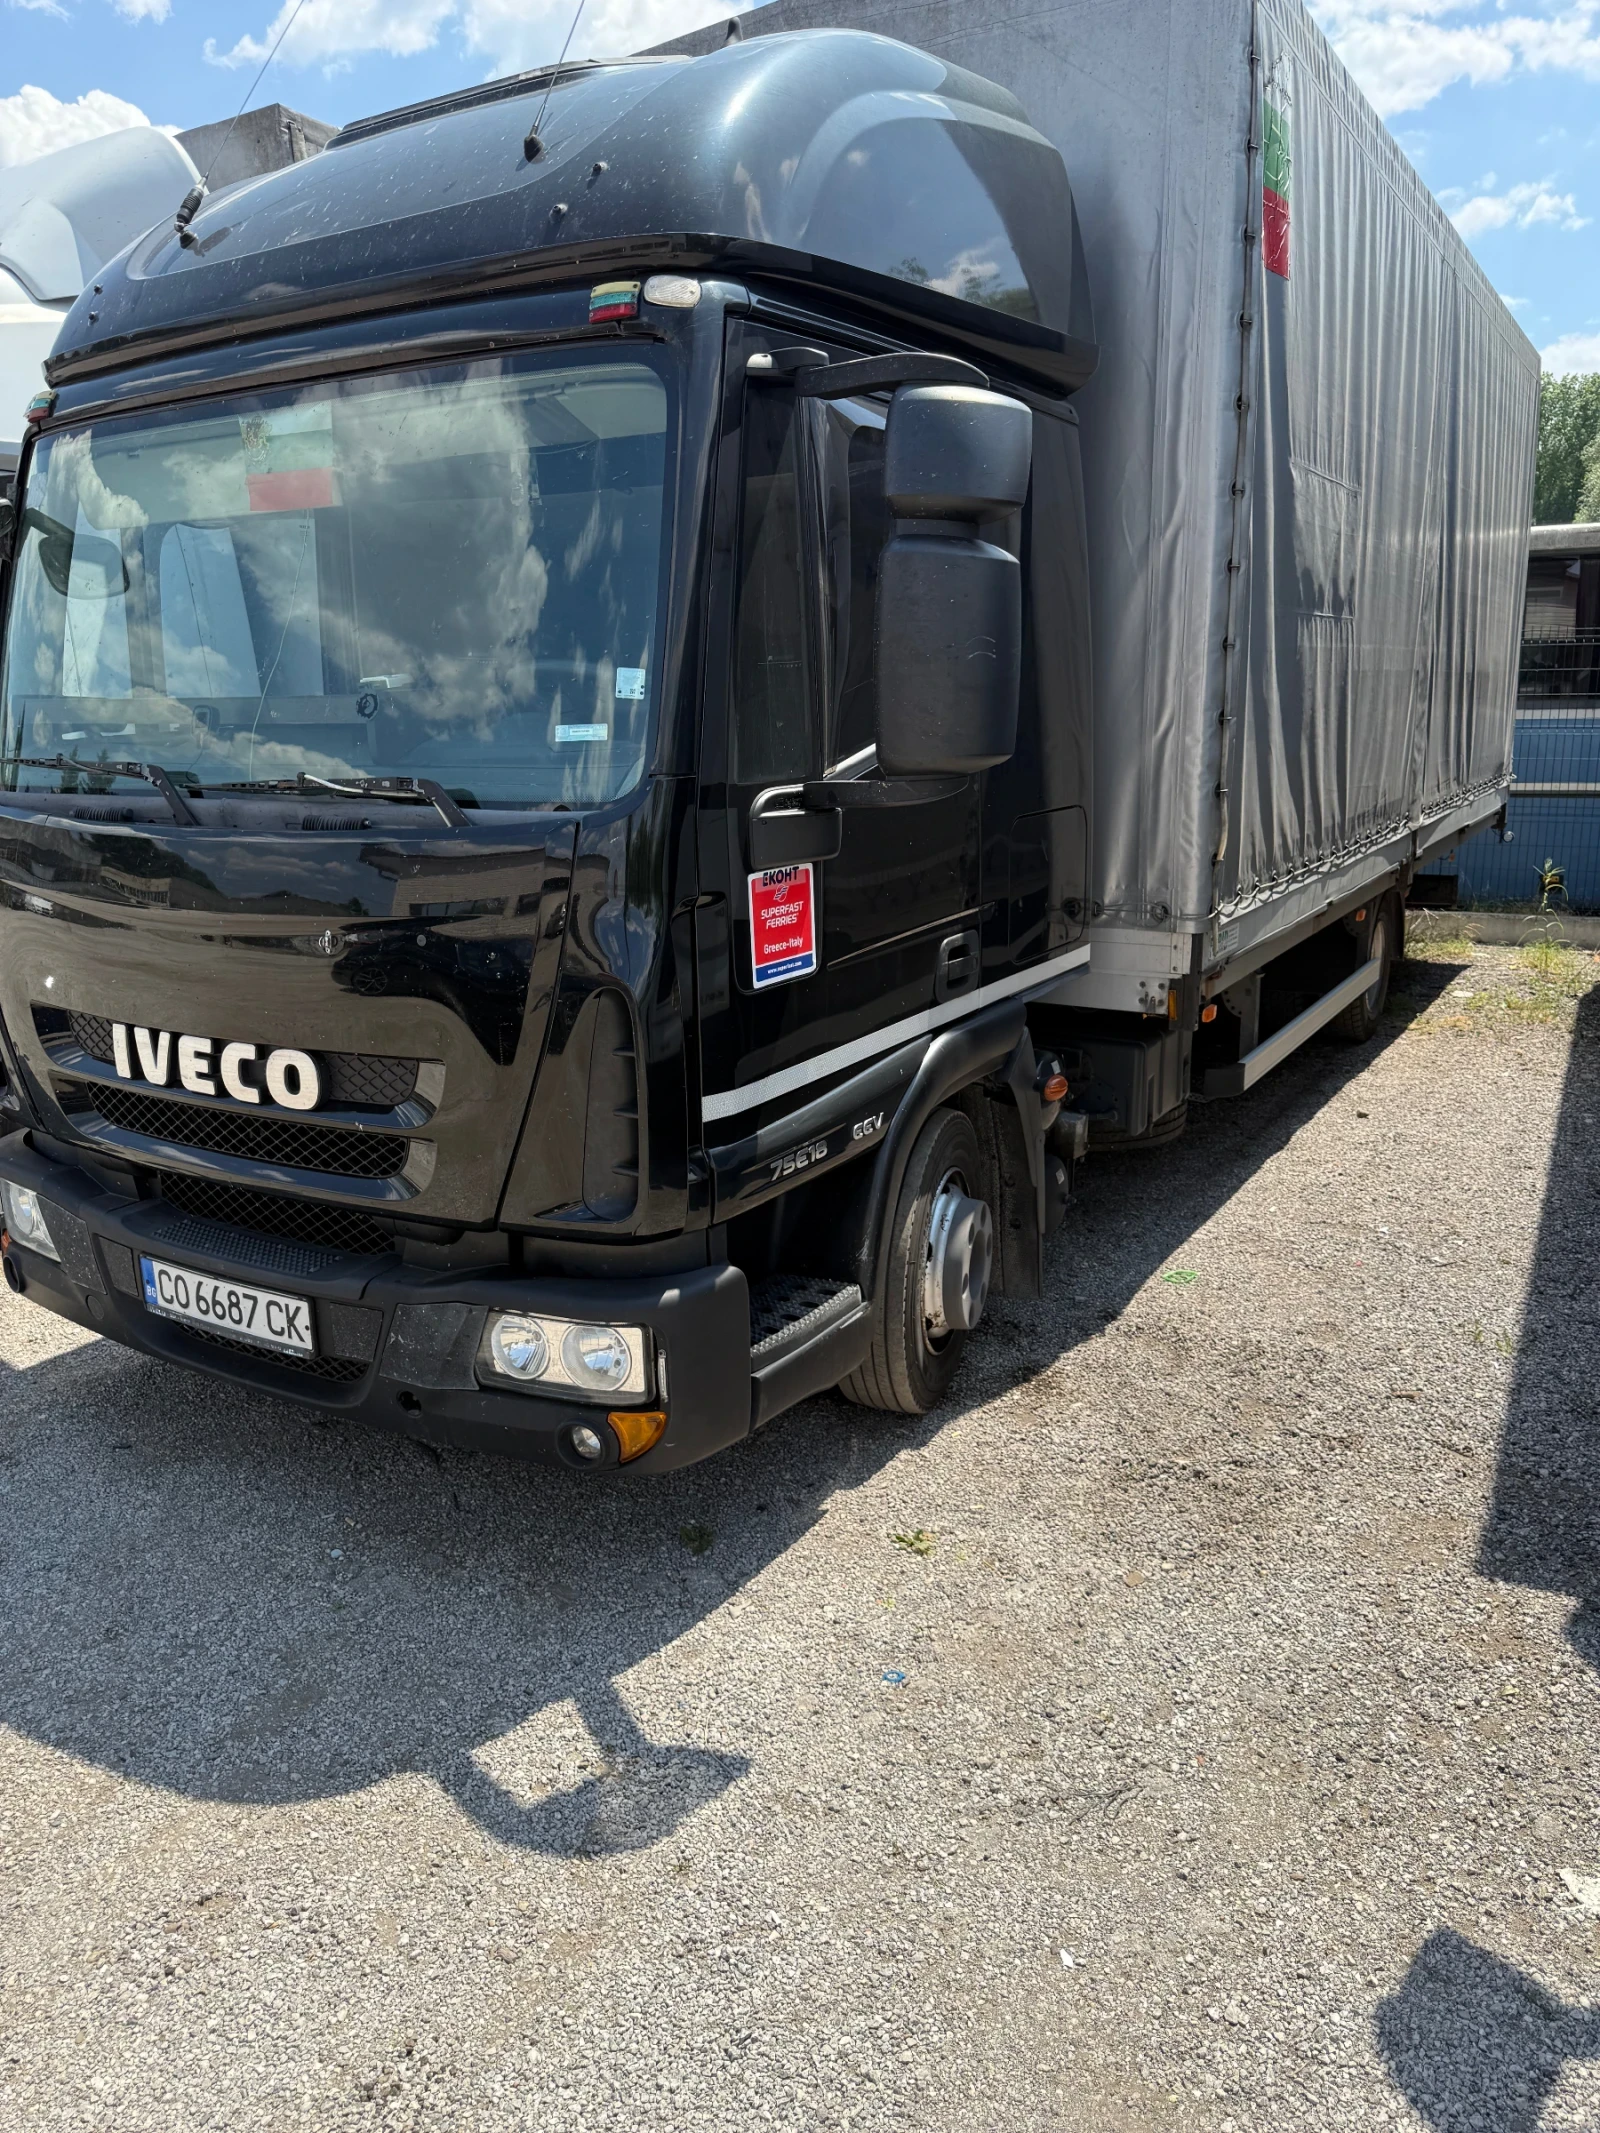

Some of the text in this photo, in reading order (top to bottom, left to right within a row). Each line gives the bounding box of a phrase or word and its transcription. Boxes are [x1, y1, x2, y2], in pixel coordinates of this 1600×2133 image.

[760, 900, 804, 920] SUPERFAST
[766, 914, 797, 930] FERRIES
[763, 937, 804, 955] Greece-Italy
[112, 1023, 322, 1111] IVECO
[852, 1112, 885, 1140] EEV
[770, 1140, 828, 1182] 75E18
[147, 1285, 157, 1297] BG
[158, 1269, 190, 1309] CO
[195, 1281, 258, 1329] 6687
[266, 1300, 306, 1343] CK
